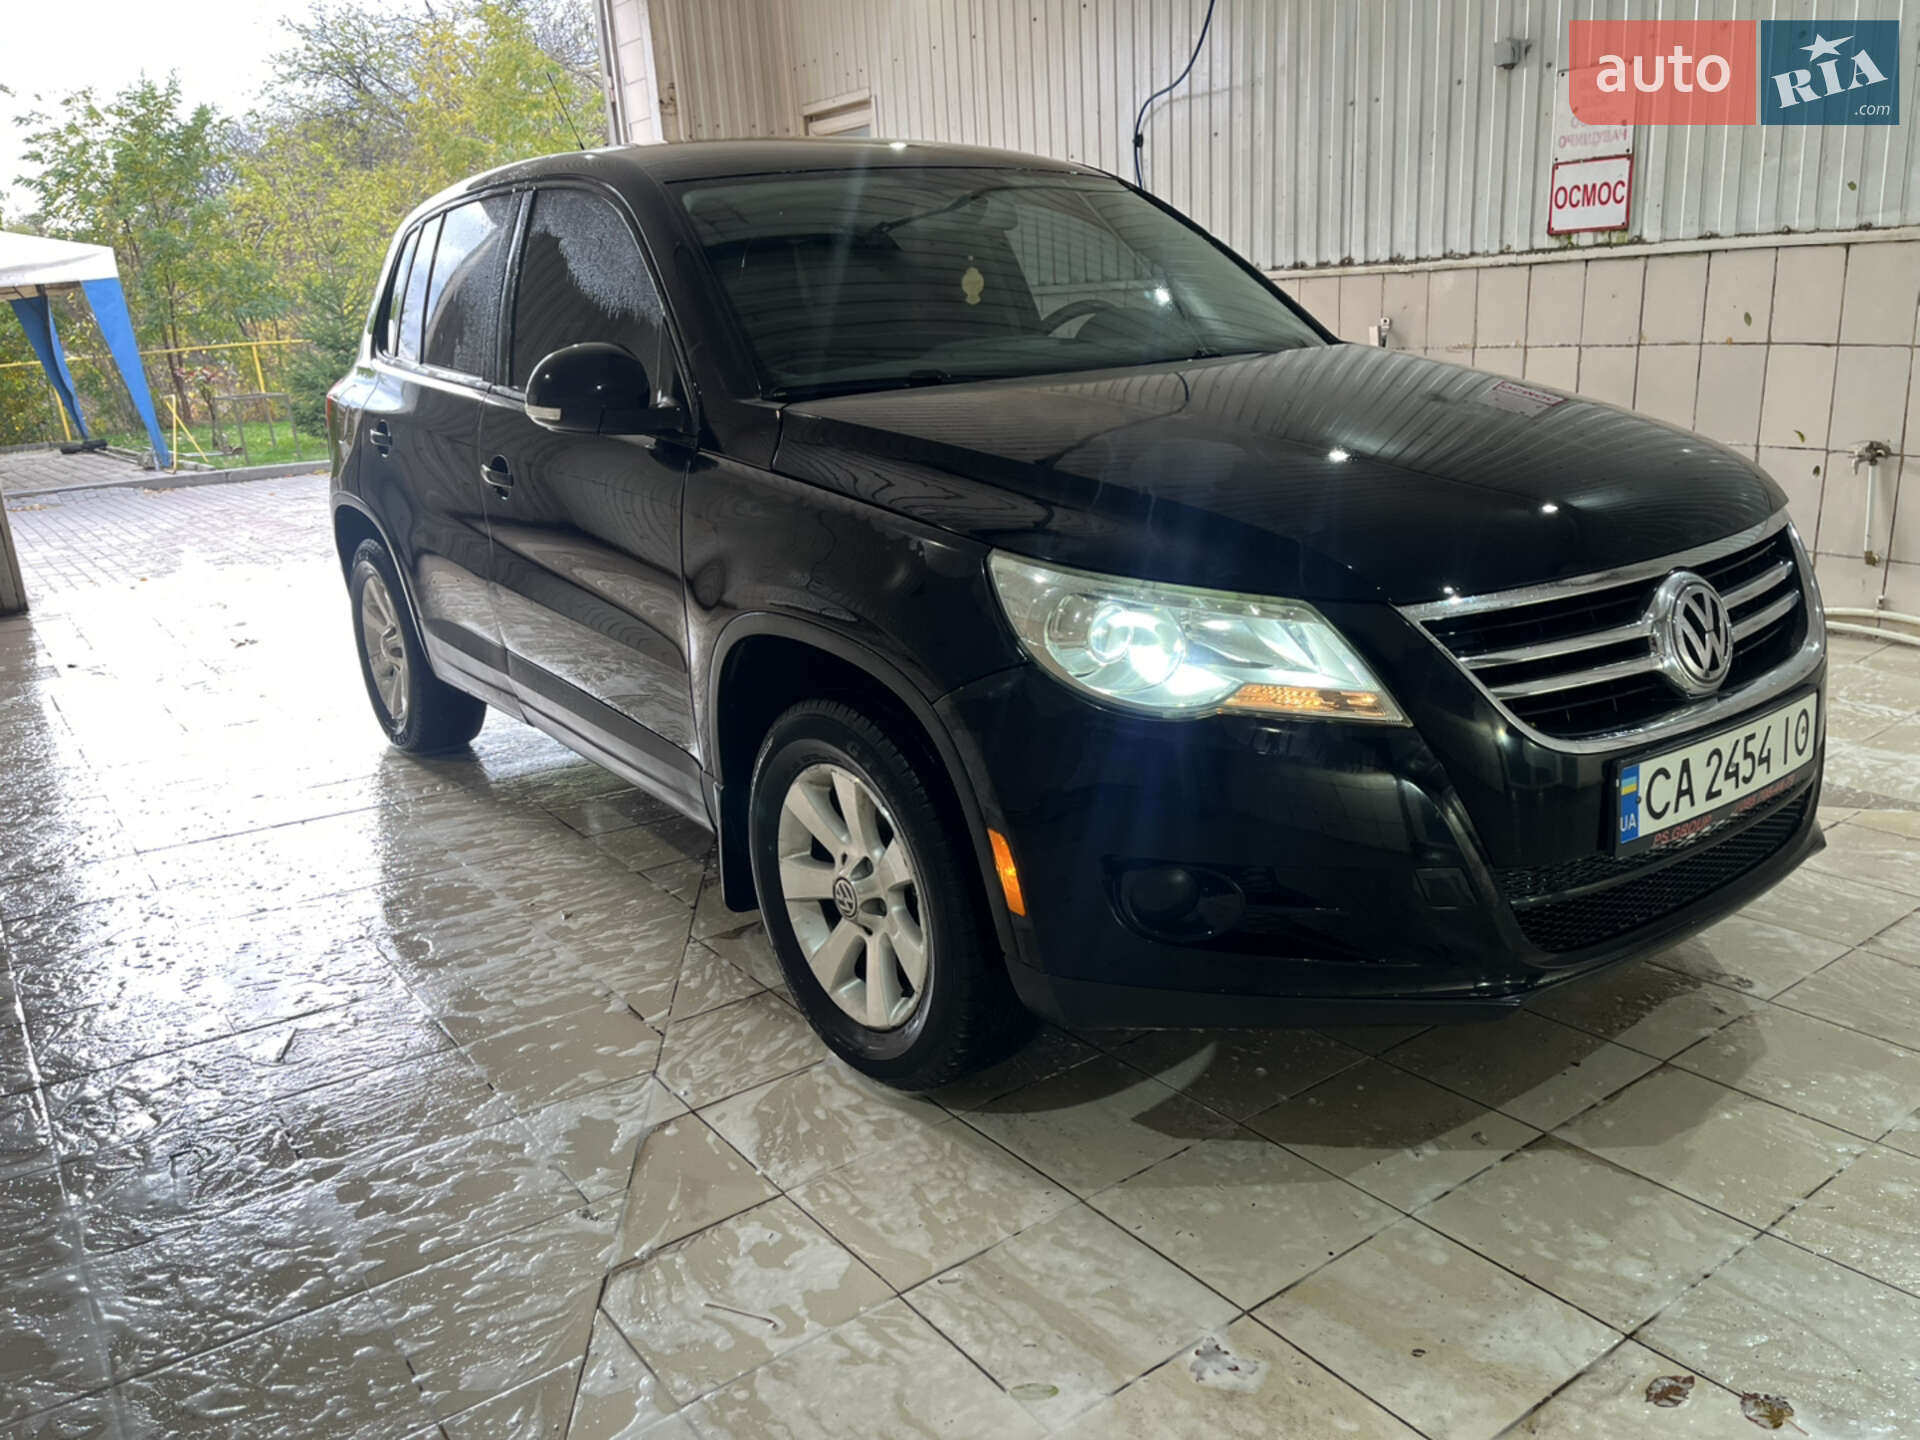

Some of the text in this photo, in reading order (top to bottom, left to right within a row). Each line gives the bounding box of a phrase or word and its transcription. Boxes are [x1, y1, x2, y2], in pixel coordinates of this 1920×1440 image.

[1554, 180, 1626, 209] ОСМОС
[1646, 758, 1695, 820] CA
[1705, 725, 1772, 802] 2454
[1620, 813, 1637, 832] UA
